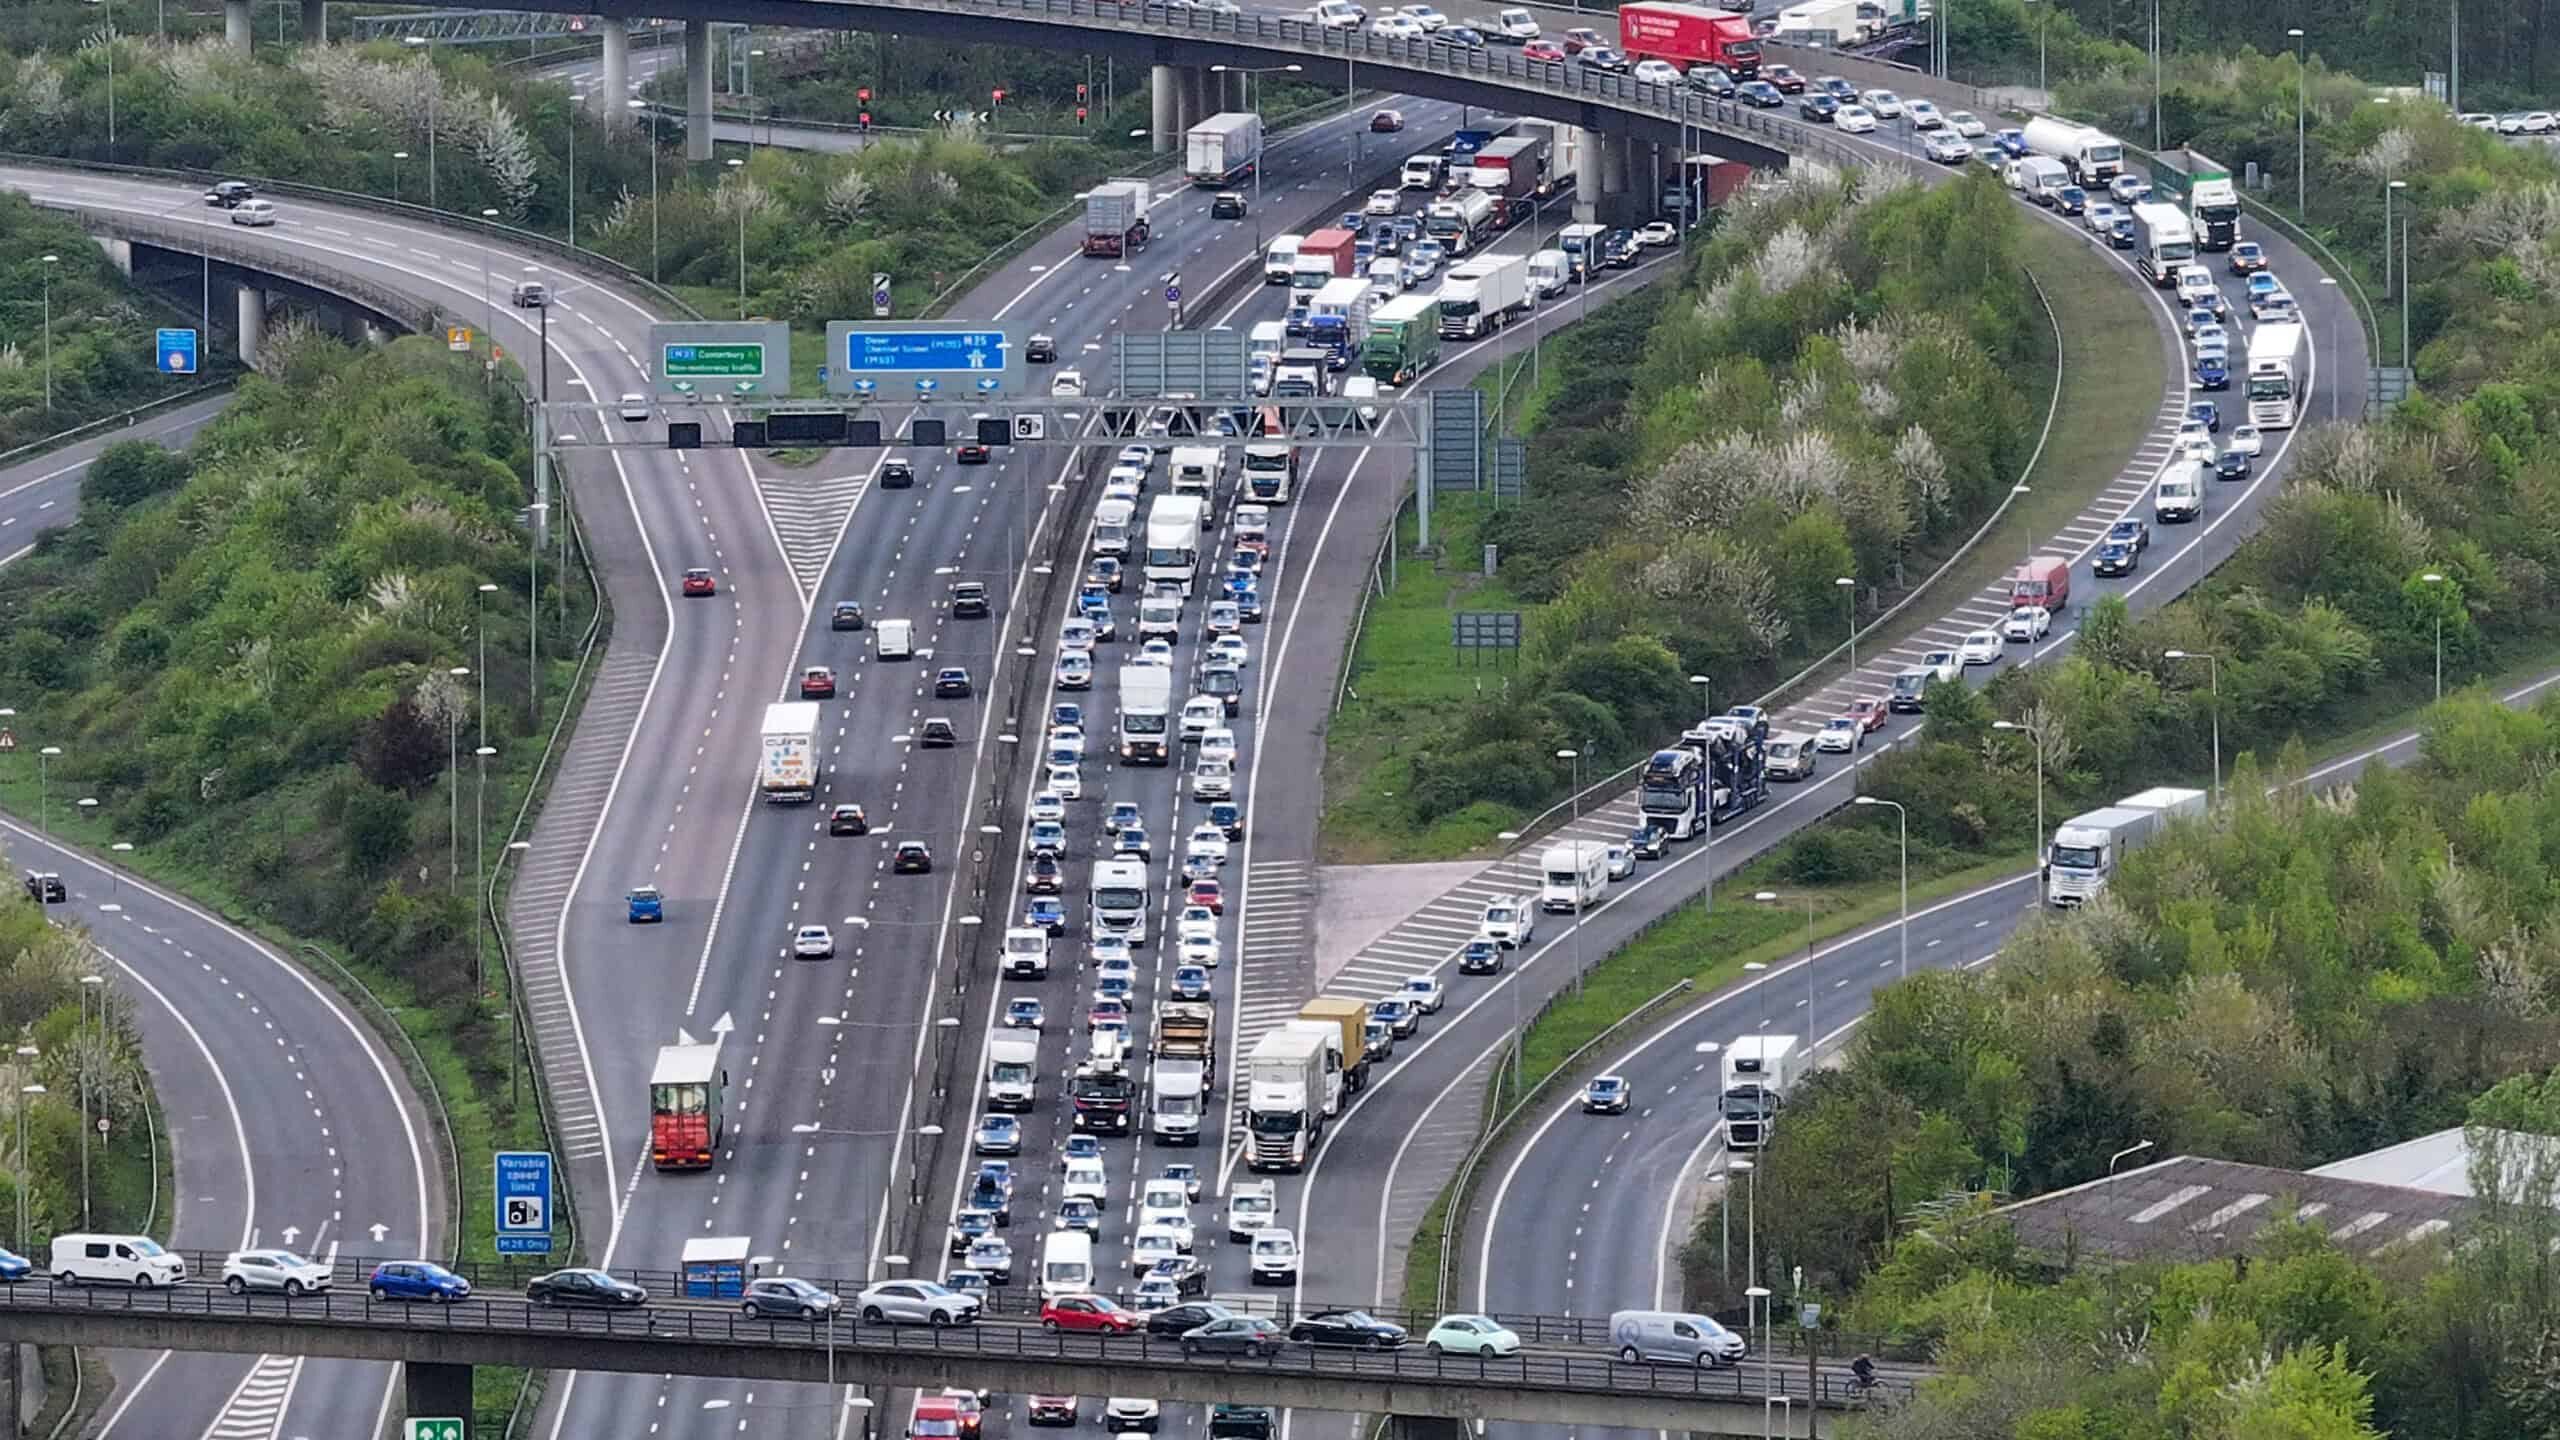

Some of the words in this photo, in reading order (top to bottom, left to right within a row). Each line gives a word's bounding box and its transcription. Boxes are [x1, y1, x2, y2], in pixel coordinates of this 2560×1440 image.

[500, 1158, 546, 1169] Variable
[507, 1169, 540, 1181] speed
[510, 1180, 536, 1192] limit
